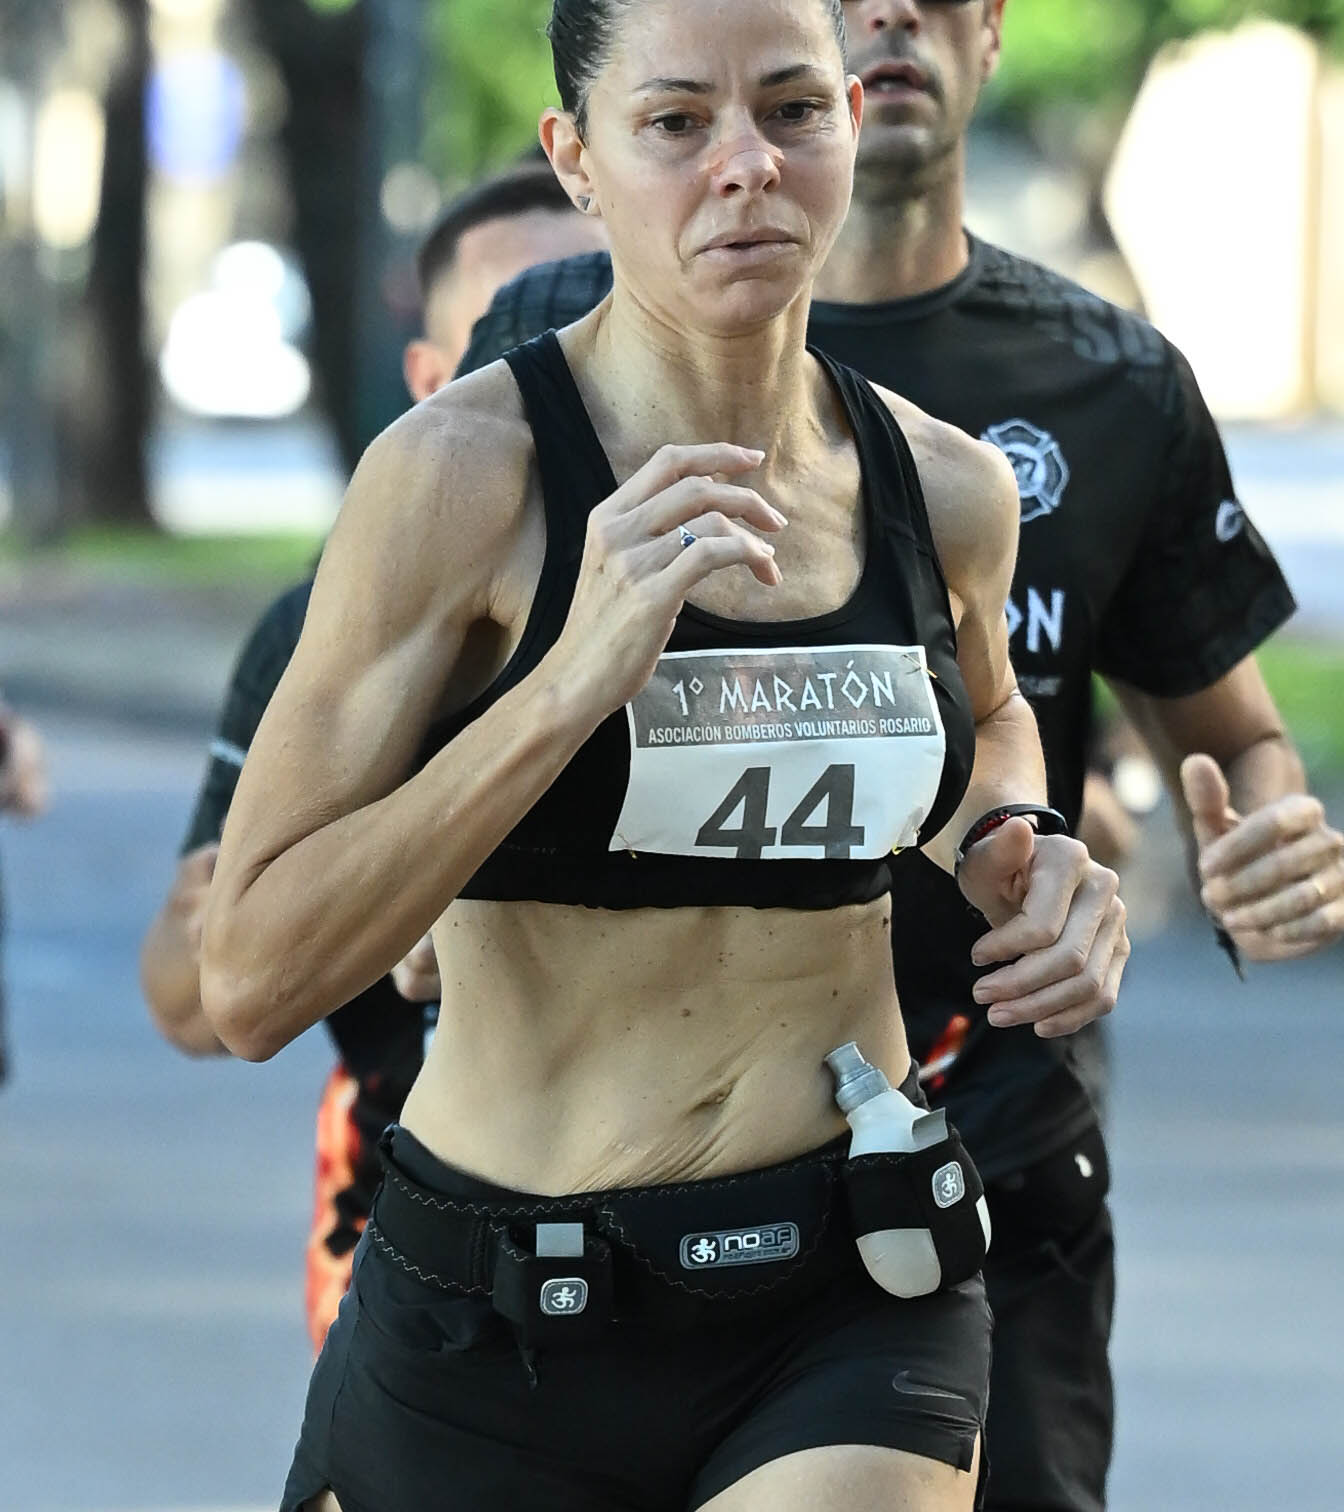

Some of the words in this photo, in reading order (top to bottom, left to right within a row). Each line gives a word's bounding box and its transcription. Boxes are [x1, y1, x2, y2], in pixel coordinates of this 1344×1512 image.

[719, 660, 897, 715] MARATÓN
[648, 721, 722, 744] ASOCIACIÓN
[724, 723, 793, 740] BOMBEROS
[794, 719, 877, 737] VOLUNTARIOS
[879, 717, 932, 734] ROSARIO
[694, 763, 866, 859] 44
